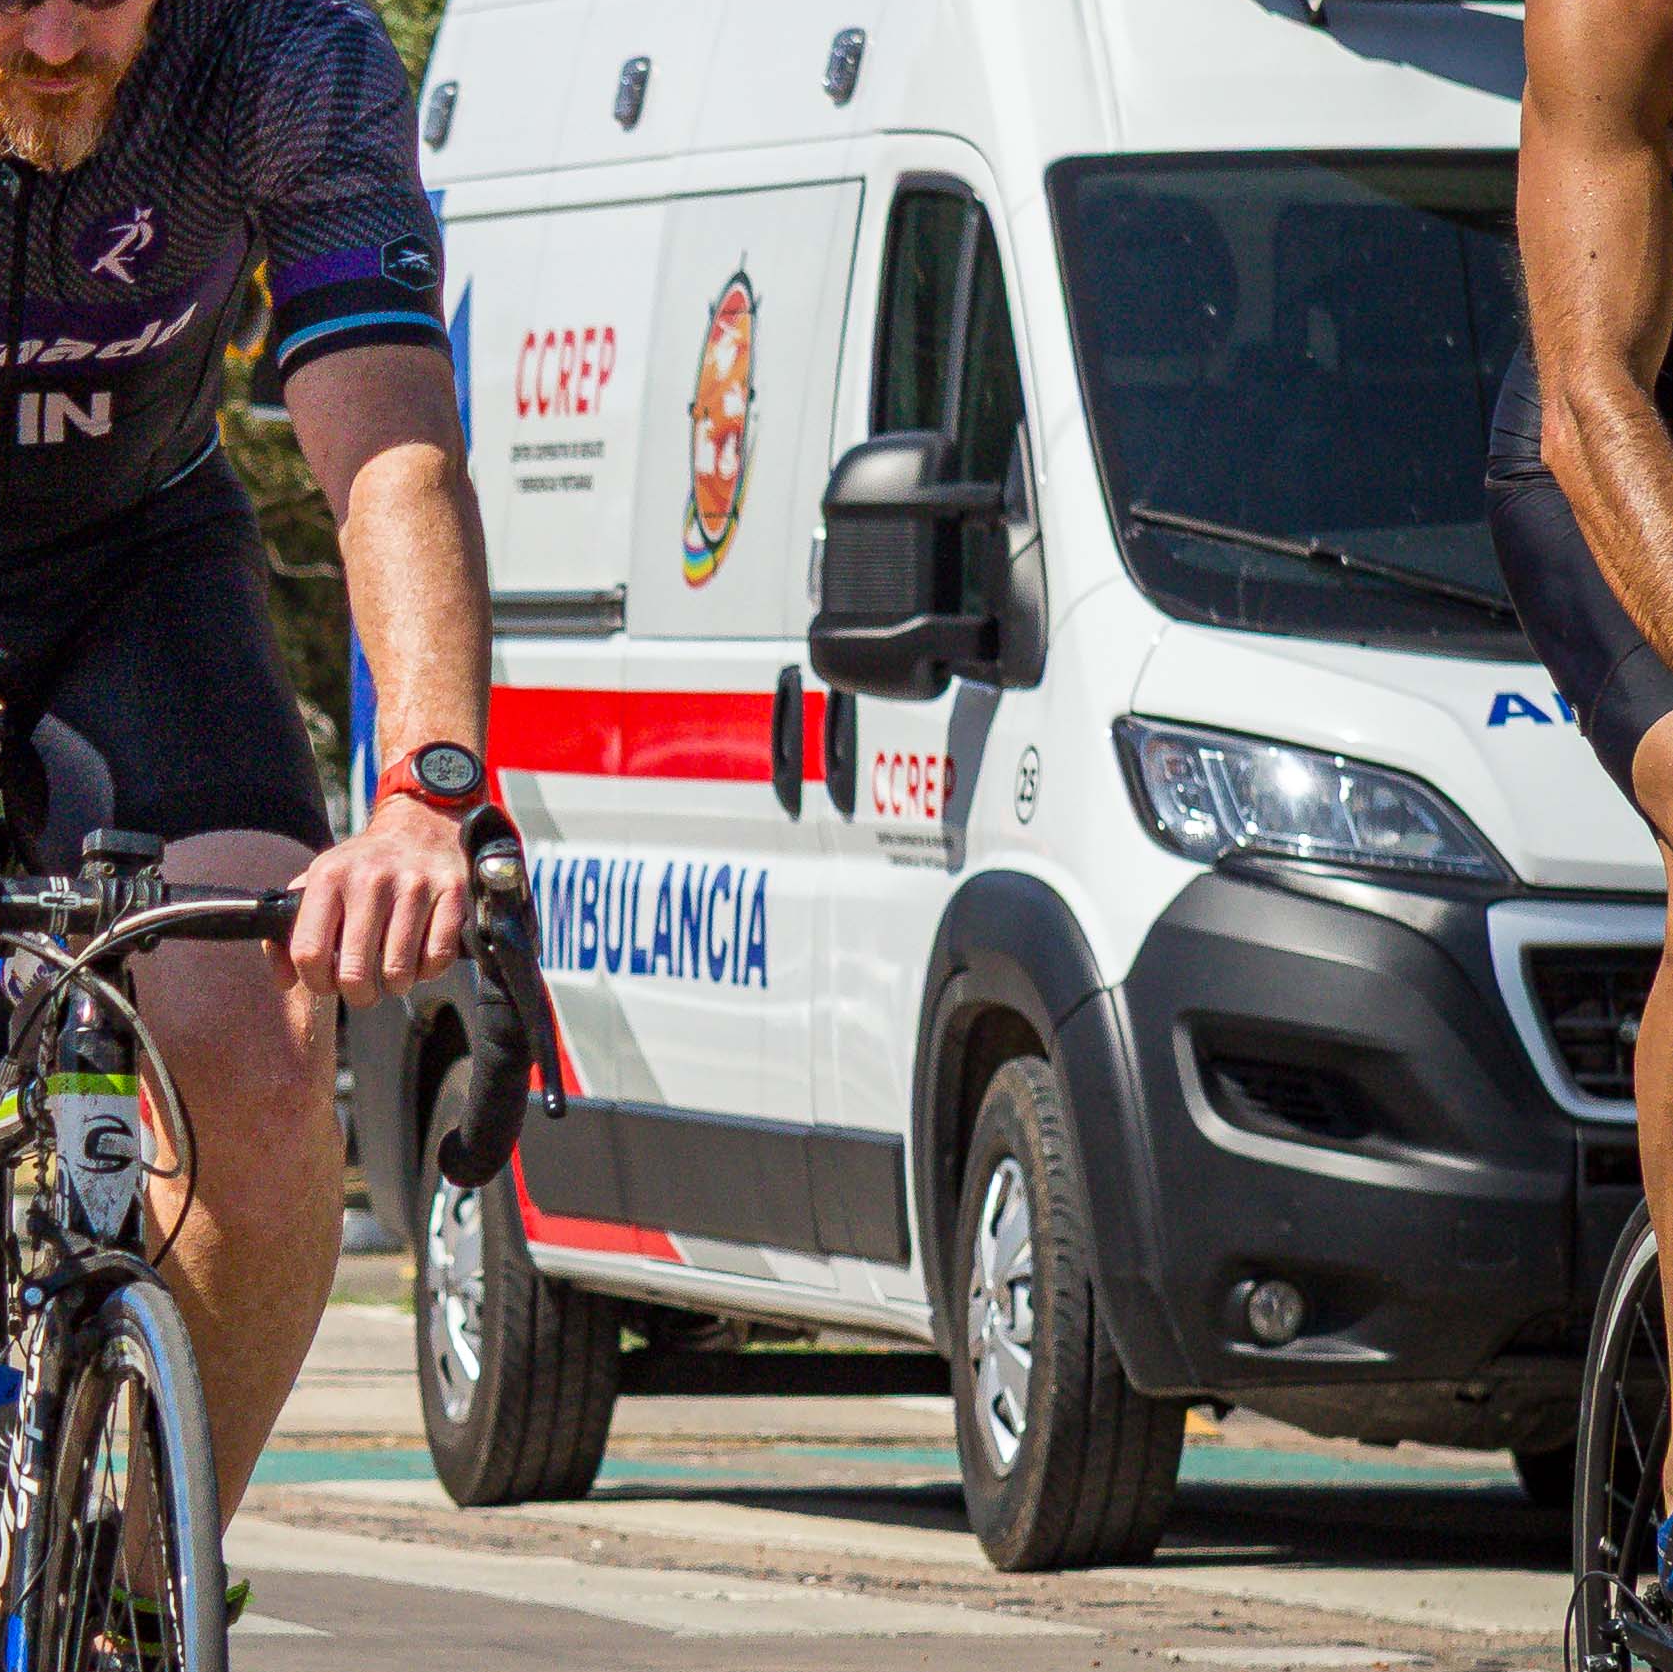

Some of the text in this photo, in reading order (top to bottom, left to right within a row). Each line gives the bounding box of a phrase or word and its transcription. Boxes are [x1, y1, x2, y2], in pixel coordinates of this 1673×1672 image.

[516, 326, 617, 418] CCREP
[17, 392, 112, 446] IN
[873, 753, 958, 819] CCREP
